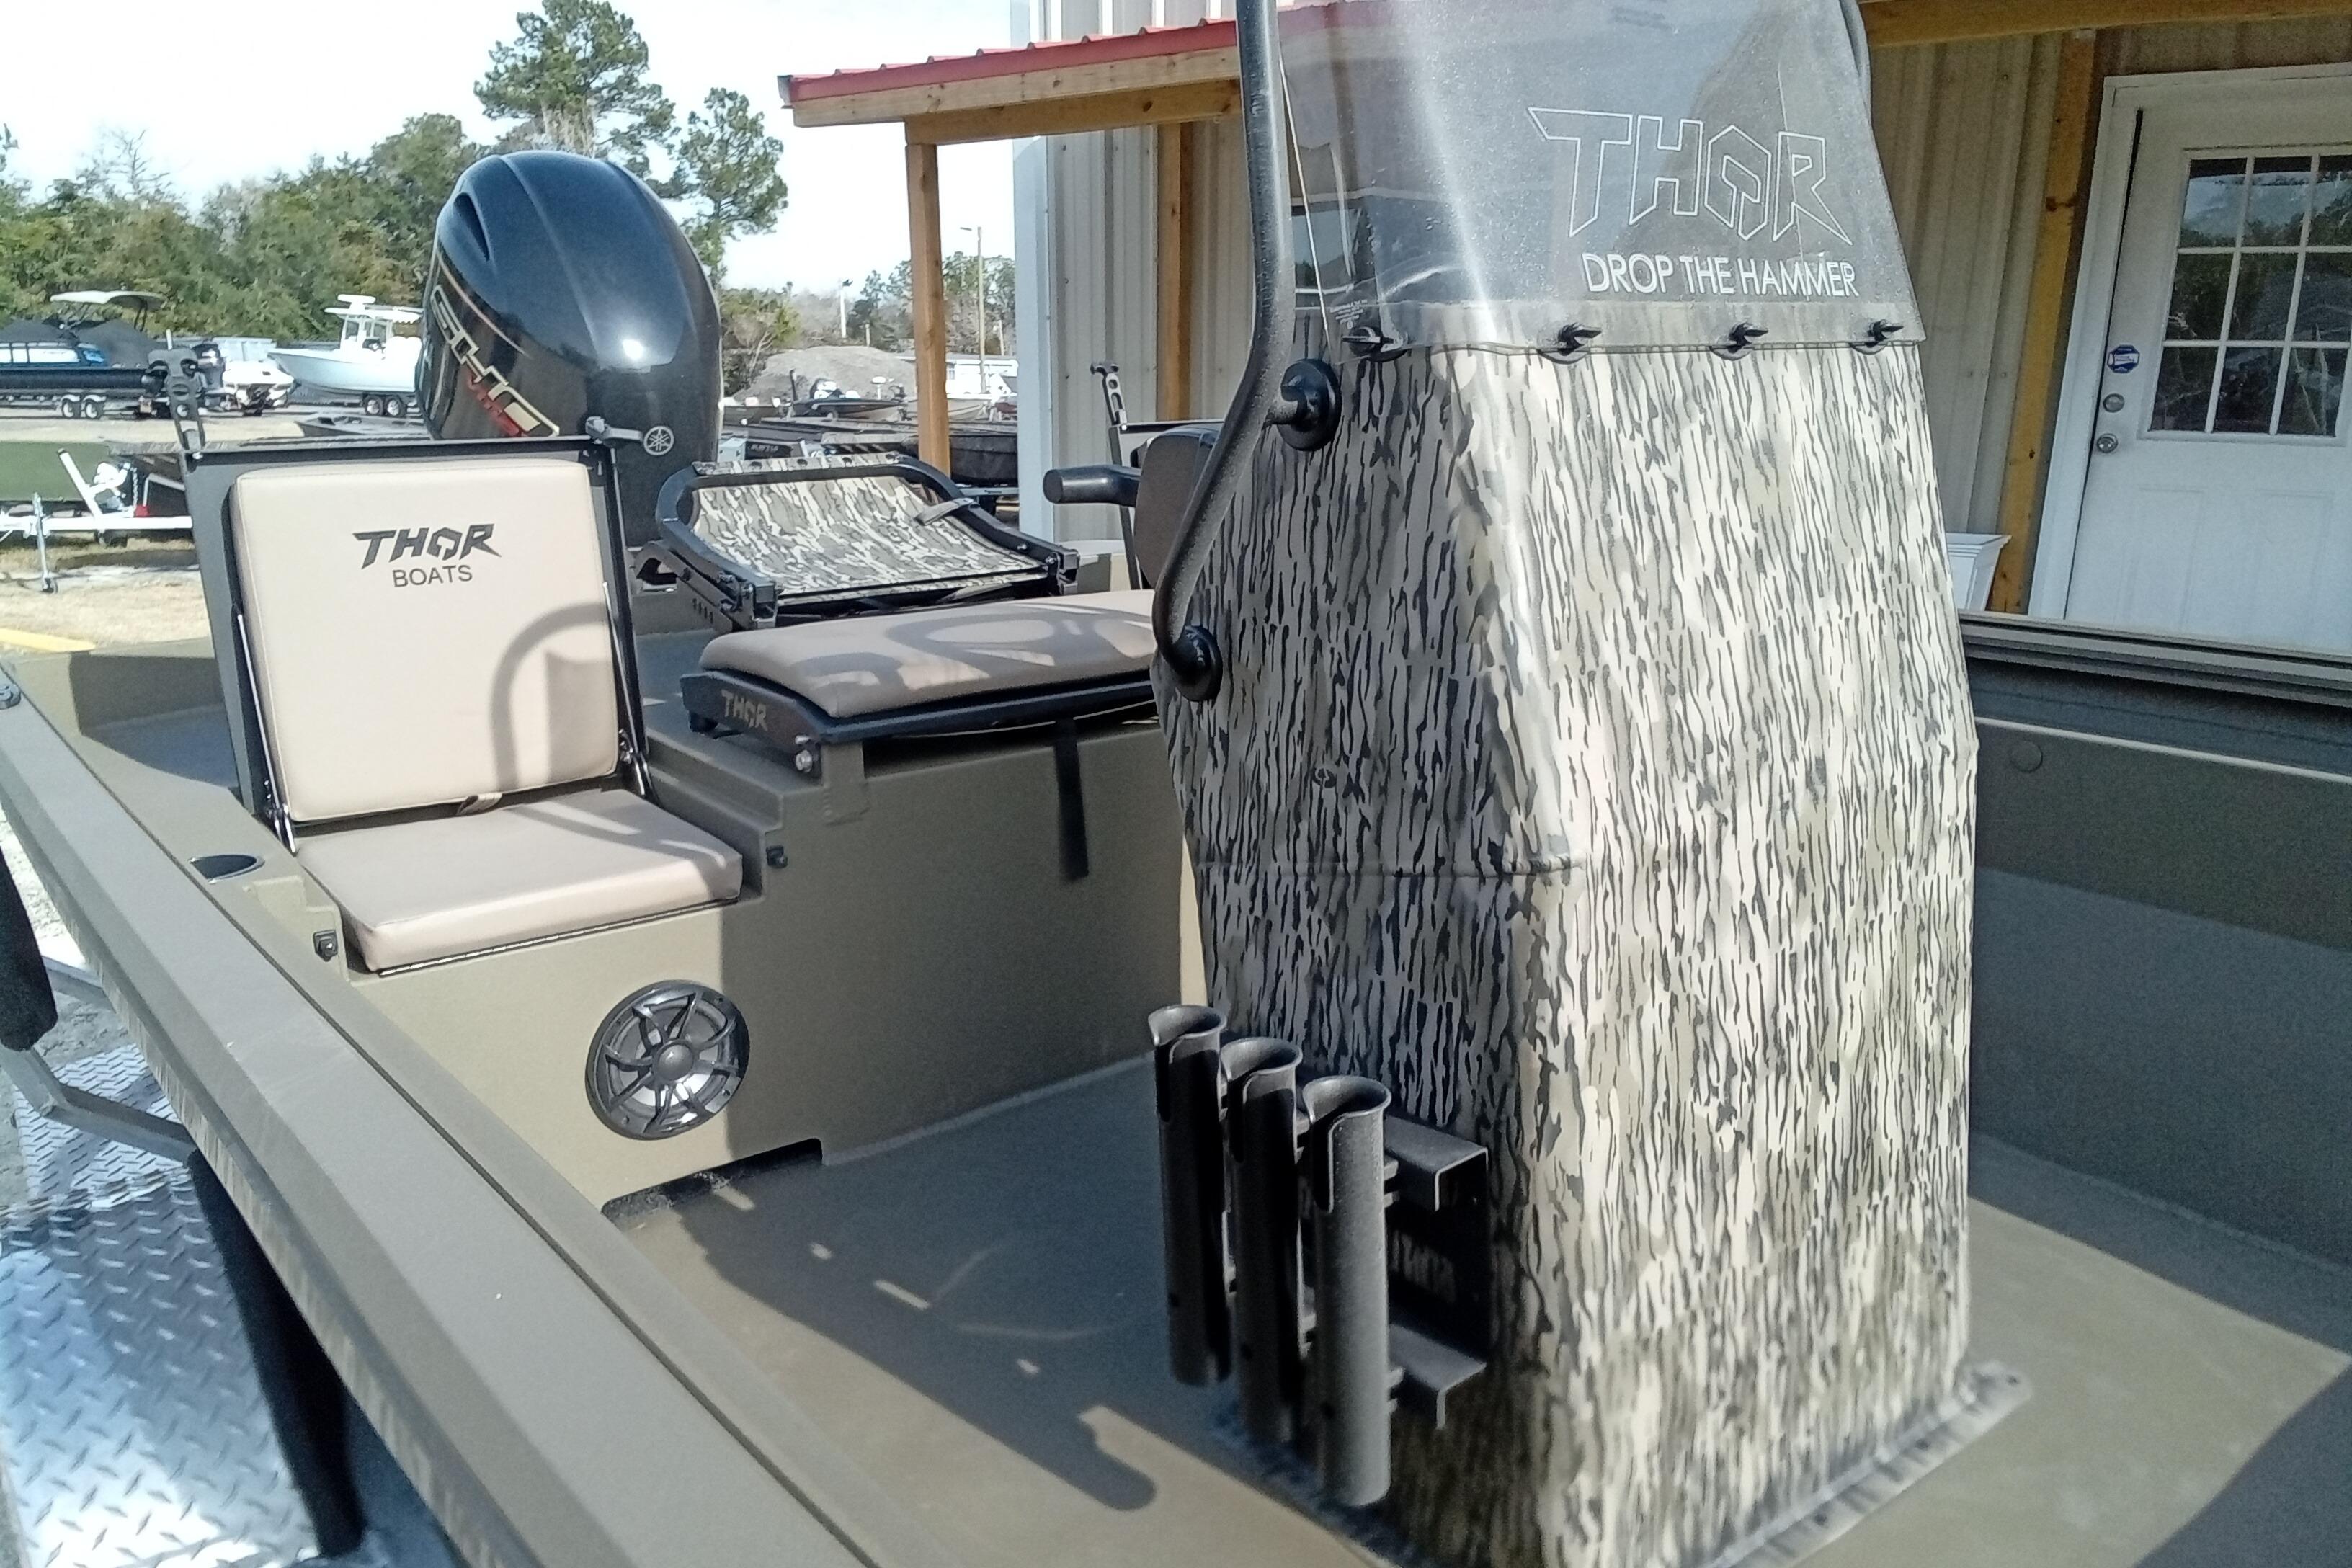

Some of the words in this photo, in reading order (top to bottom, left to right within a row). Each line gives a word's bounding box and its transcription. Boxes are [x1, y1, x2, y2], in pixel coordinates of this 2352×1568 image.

[1527, 106, 1853, 246] THOR
[1581, 252, 1674, 293] DROP
[1679, 256, 1734, 295] THE
[1737, 257, 1859, 297] HAMMER
[352, 523, 502, 570] THOR
[392, 564, 473, 587] BOATS
[721, 689, 768, 731] THOR
